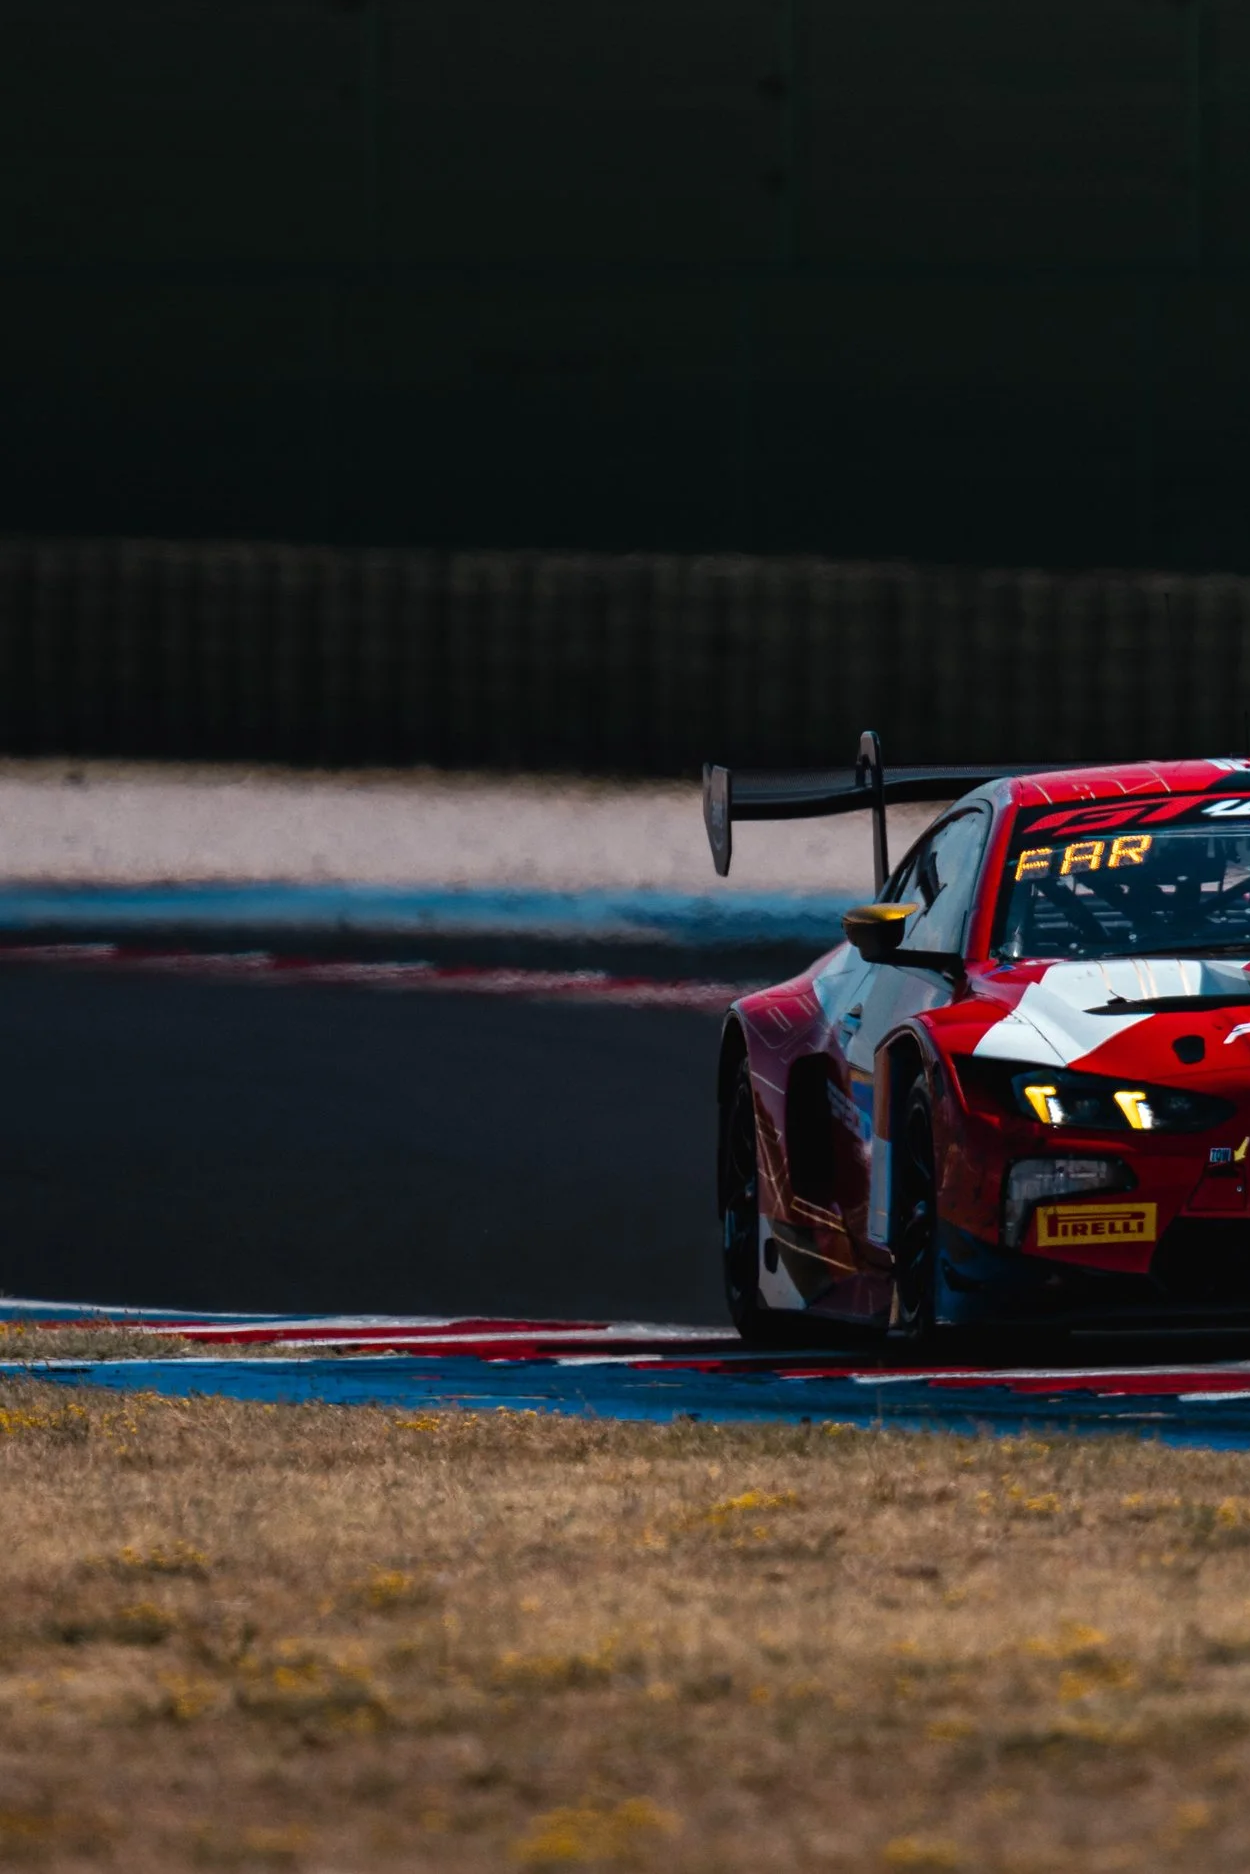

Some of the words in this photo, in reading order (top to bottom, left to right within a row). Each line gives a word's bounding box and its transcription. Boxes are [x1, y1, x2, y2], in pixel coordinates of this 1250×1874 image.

[1014, 834, 1153, 882] FAR
[1211, 1148, 1230, 1162] TOW
[1047, 1211, 1146, 1238] PIRELLI
